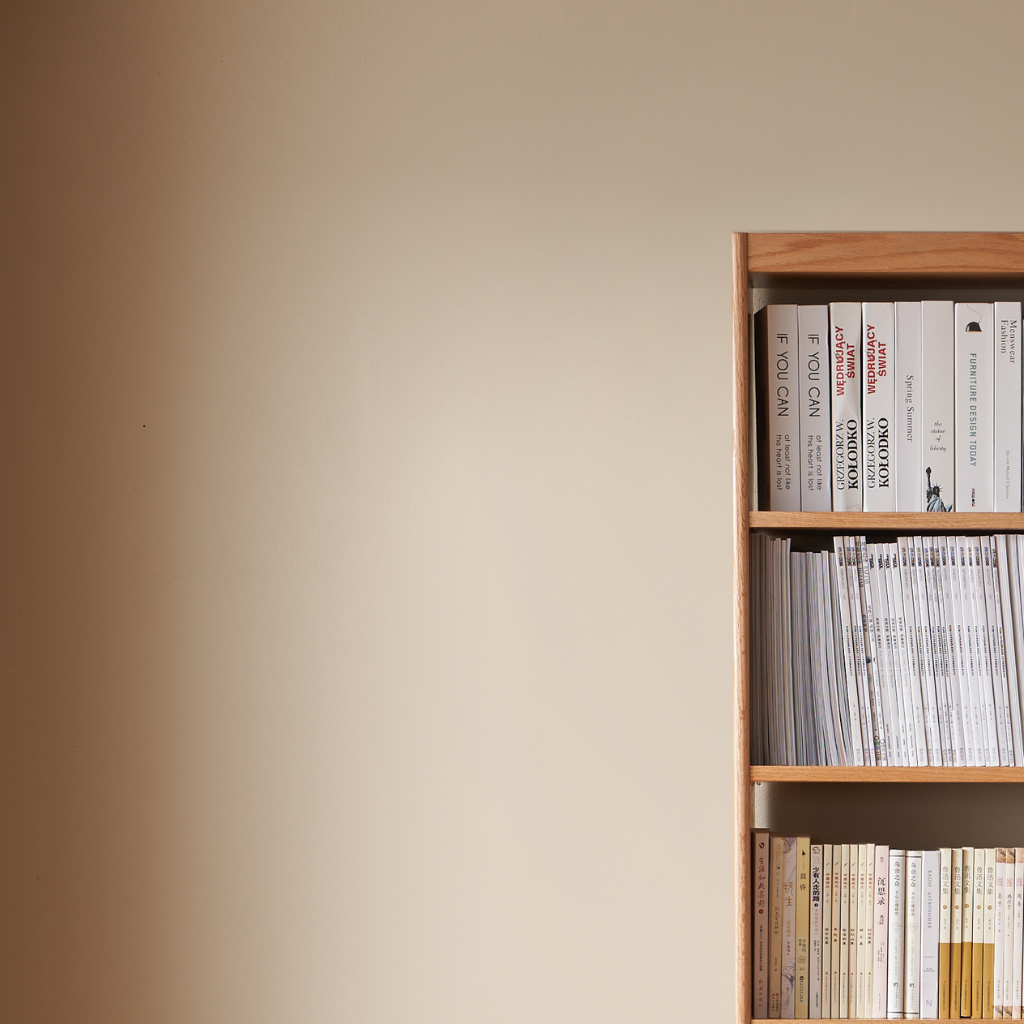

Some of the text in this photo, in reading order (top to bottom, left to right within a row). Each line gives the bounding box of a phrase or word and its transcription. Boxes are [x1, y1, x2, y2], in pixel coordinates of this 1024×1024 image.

[833, 326, 845, 396] WĘDRUJĄCY
[846, 344, 855, 379] ŚWIAT
[865, 324, 876, 395] WĘDRUJĄCY
[877, 342, 886, 377] ŚWIAT
[1000, 319, 1008, 354] Fashion
[1009, 319, 1017, 364] Menswear
[777, 334, 789, 416] IF YOU CAN
[808, 334, 820, 416] IF YOU CAN
[905, 375, 913, 403] Spring
[969, 353, 977, 467] FURNITURE DESIGN TODAY
[837, 419, 845, 490] GRZEGORZ W.
[847, 419, 858, 489] KOŁODKO
[868, 418, 876, 489] GRZEGORZ W.
[878, 418, 889, 488] KOŁODKO
[812, 866, 820, 902] 少有人走的路
[877, 878, 886, 906] 沉思录
